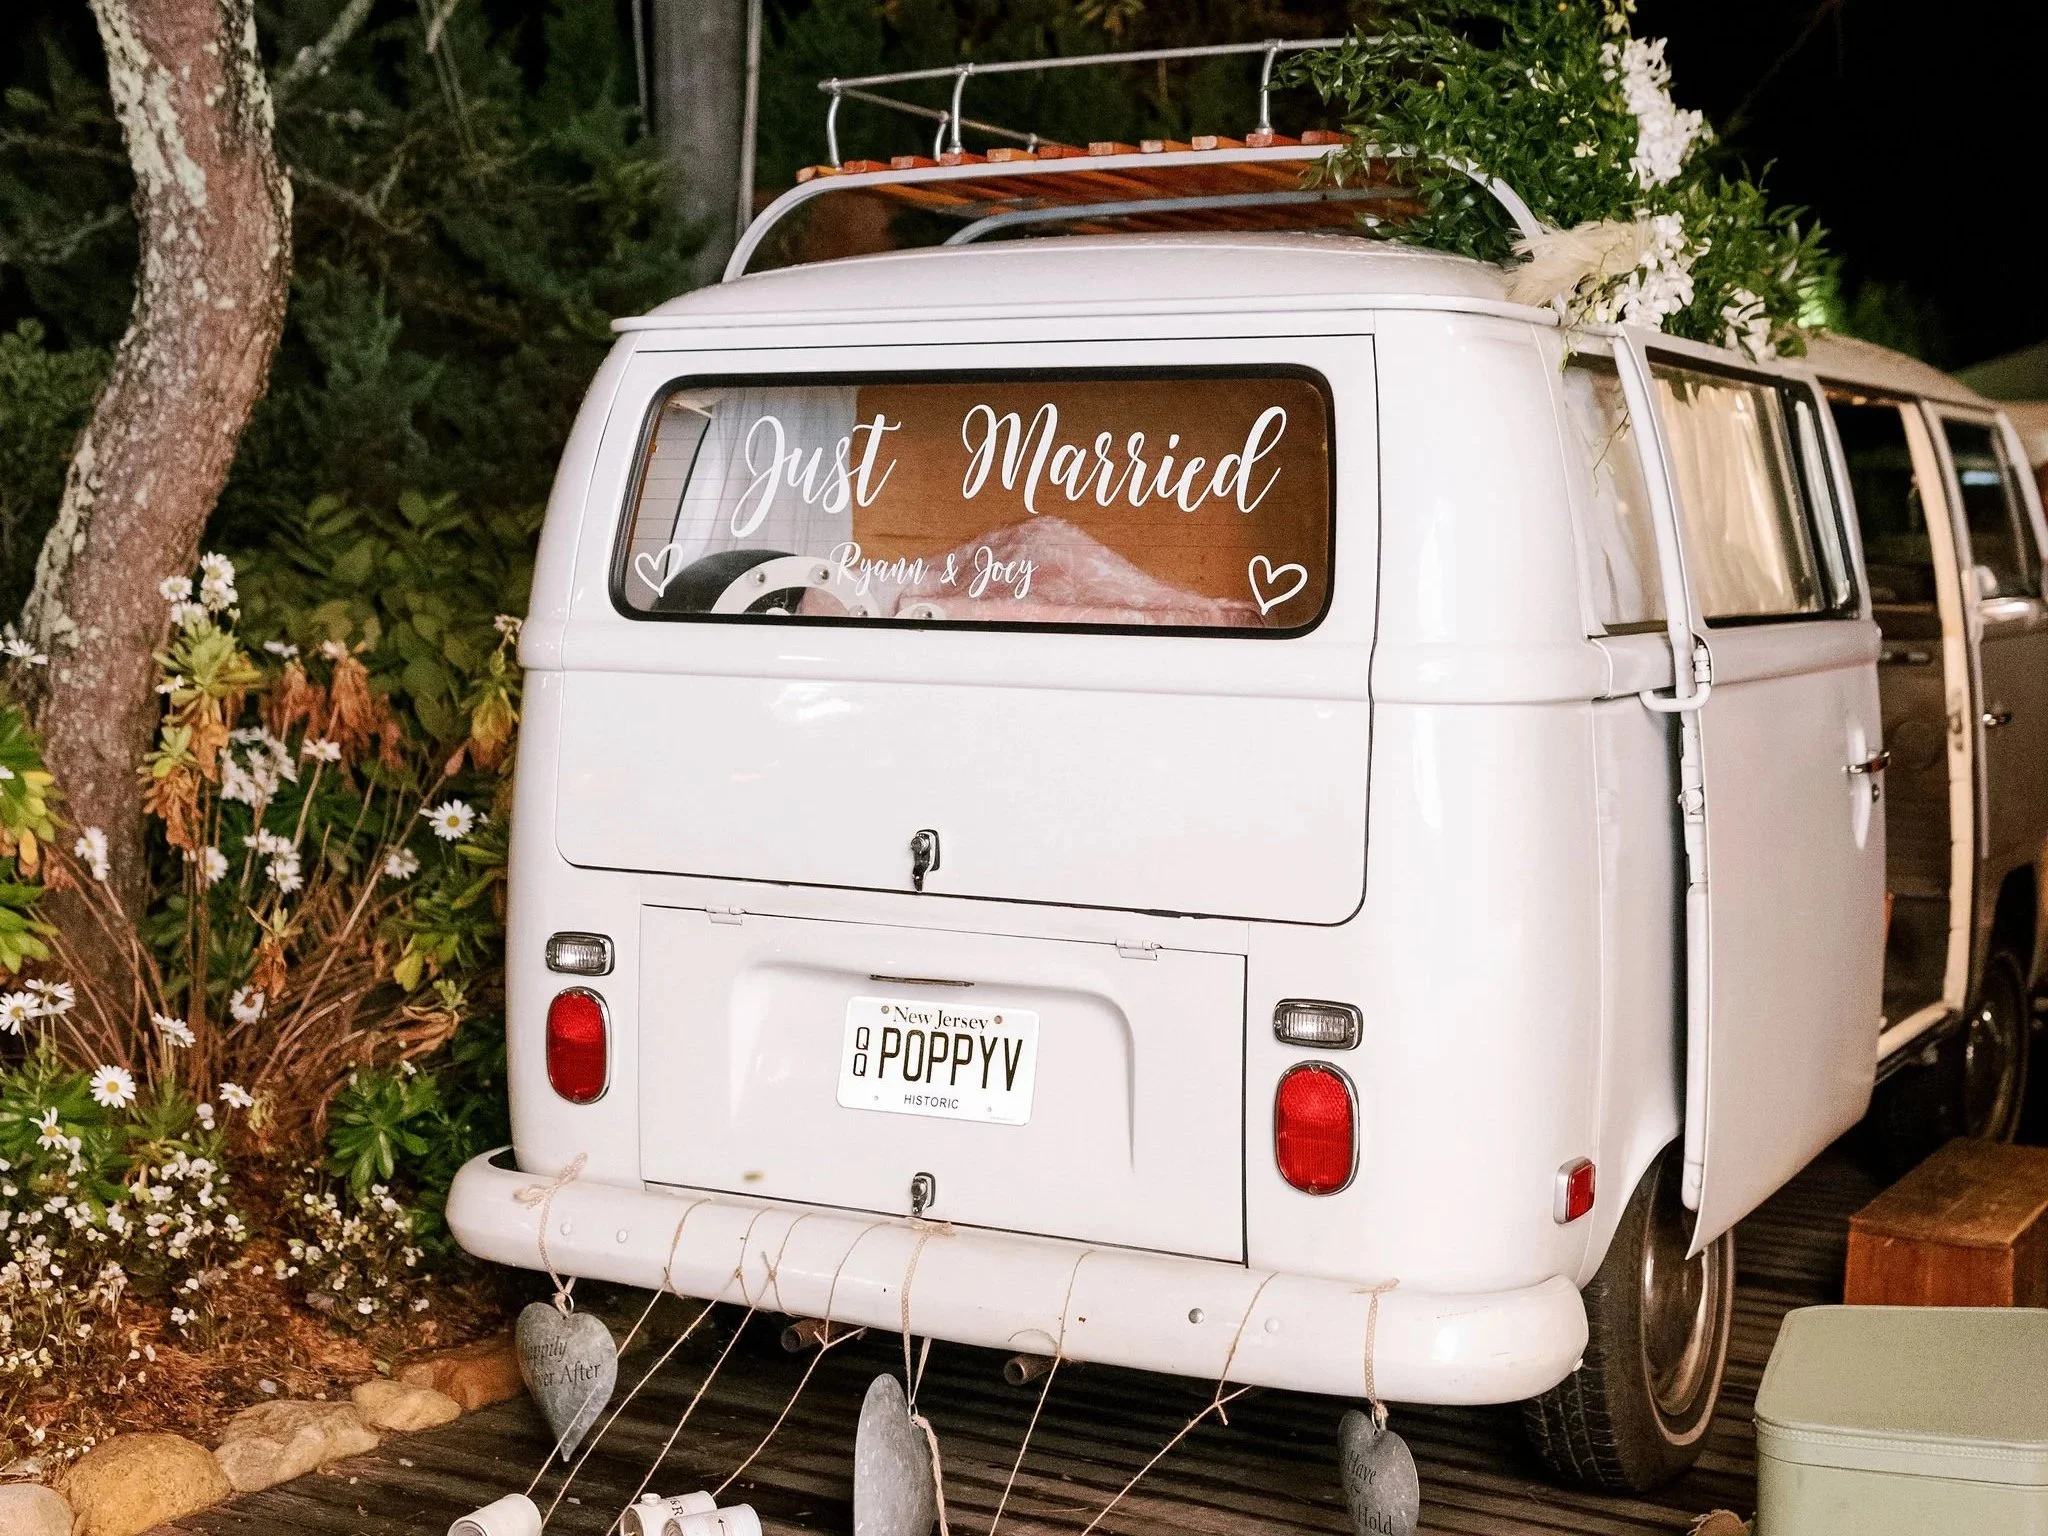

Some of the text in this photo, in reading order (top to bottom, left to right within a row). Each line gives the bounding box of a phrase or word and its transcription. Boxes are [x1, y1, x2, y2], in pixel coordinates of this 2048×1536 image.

[730, 403, 1287, 538] Just Married
[829, 541, 1039, 599] Ryann & Joey
[893, 1006, 990, 1034] New Jersey
[878, 1026, 1023, 1091] POPPYV
[903, 1094, 959, 1110] HISTORIC
[560, 1360, 601, 1390] After
[1347, 1450, 1377, 1485] Have
[1358, 1503, 1393, 1536] Hold
